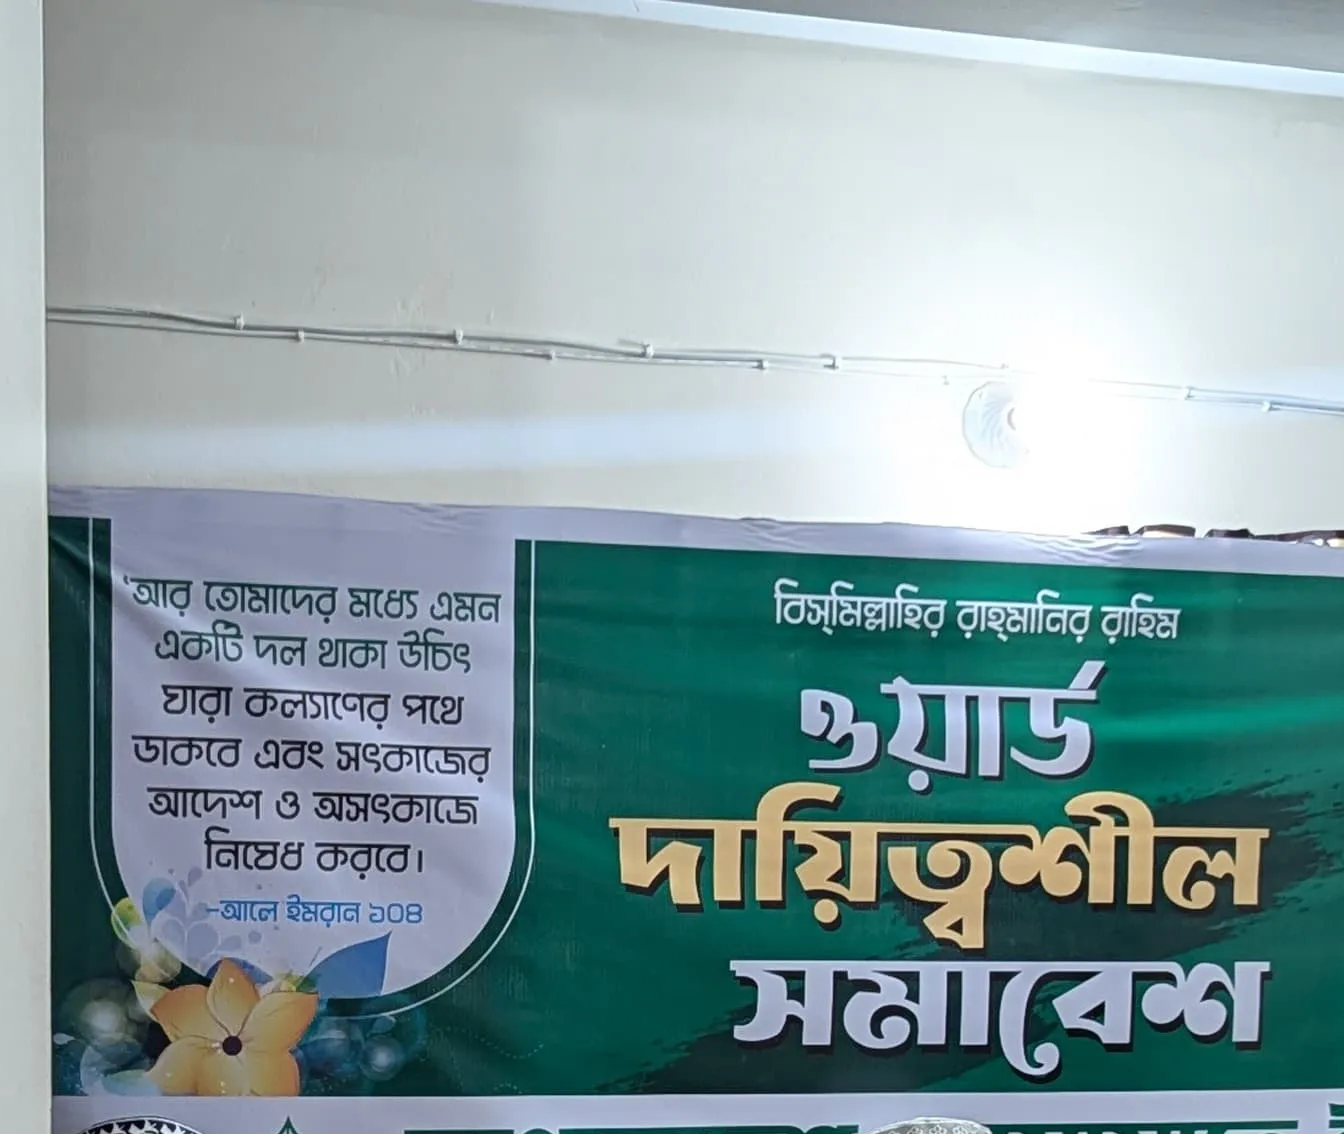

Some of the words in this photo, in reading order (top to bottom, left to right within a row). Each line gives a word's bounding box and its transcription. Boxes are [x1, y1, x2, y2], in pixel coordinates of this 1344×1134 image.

[204, 581, 338, 624] তোমাদের
[349, 587, 418, 621] মধ্যে
[431, 592, 501, 624] এমন
[1101, 592, 1182, 644] রাহিম
[155, 620, 242, 662] একটি
[254, 635, 307, 668] দল
[318, 638, 387, 670] থাকা
[398, 628, 471, 674] উচিৎ
[162, 685, 232, 723] যারা
[244, 688, 390, 729] কল্যাণের
[403, 695, 464, 726] পথে
[799, 660, 1107, 793] ওয়ার্ড
[132, 735, 241, 768] ডাকবে
[254, 740, 324, 770] এবং
[336, 742, 491, 783] সৎকাজের
[147, 787, 262, 819] আদেশ
[276, 795, 300, 820] ও
[313, 791, 479, 826] অসৎকাজে
[205, 827, 304, 871] নিষেধ
[315, 842, 423, 880] করবে।
[608, 781, 1271, 952] দায়িত্বশীল
[286, 894, 360, 929] ইমরান
[369, 902, 422, 924] ১০৪
[729, 960, 1271, 1078] সমাবেশ
